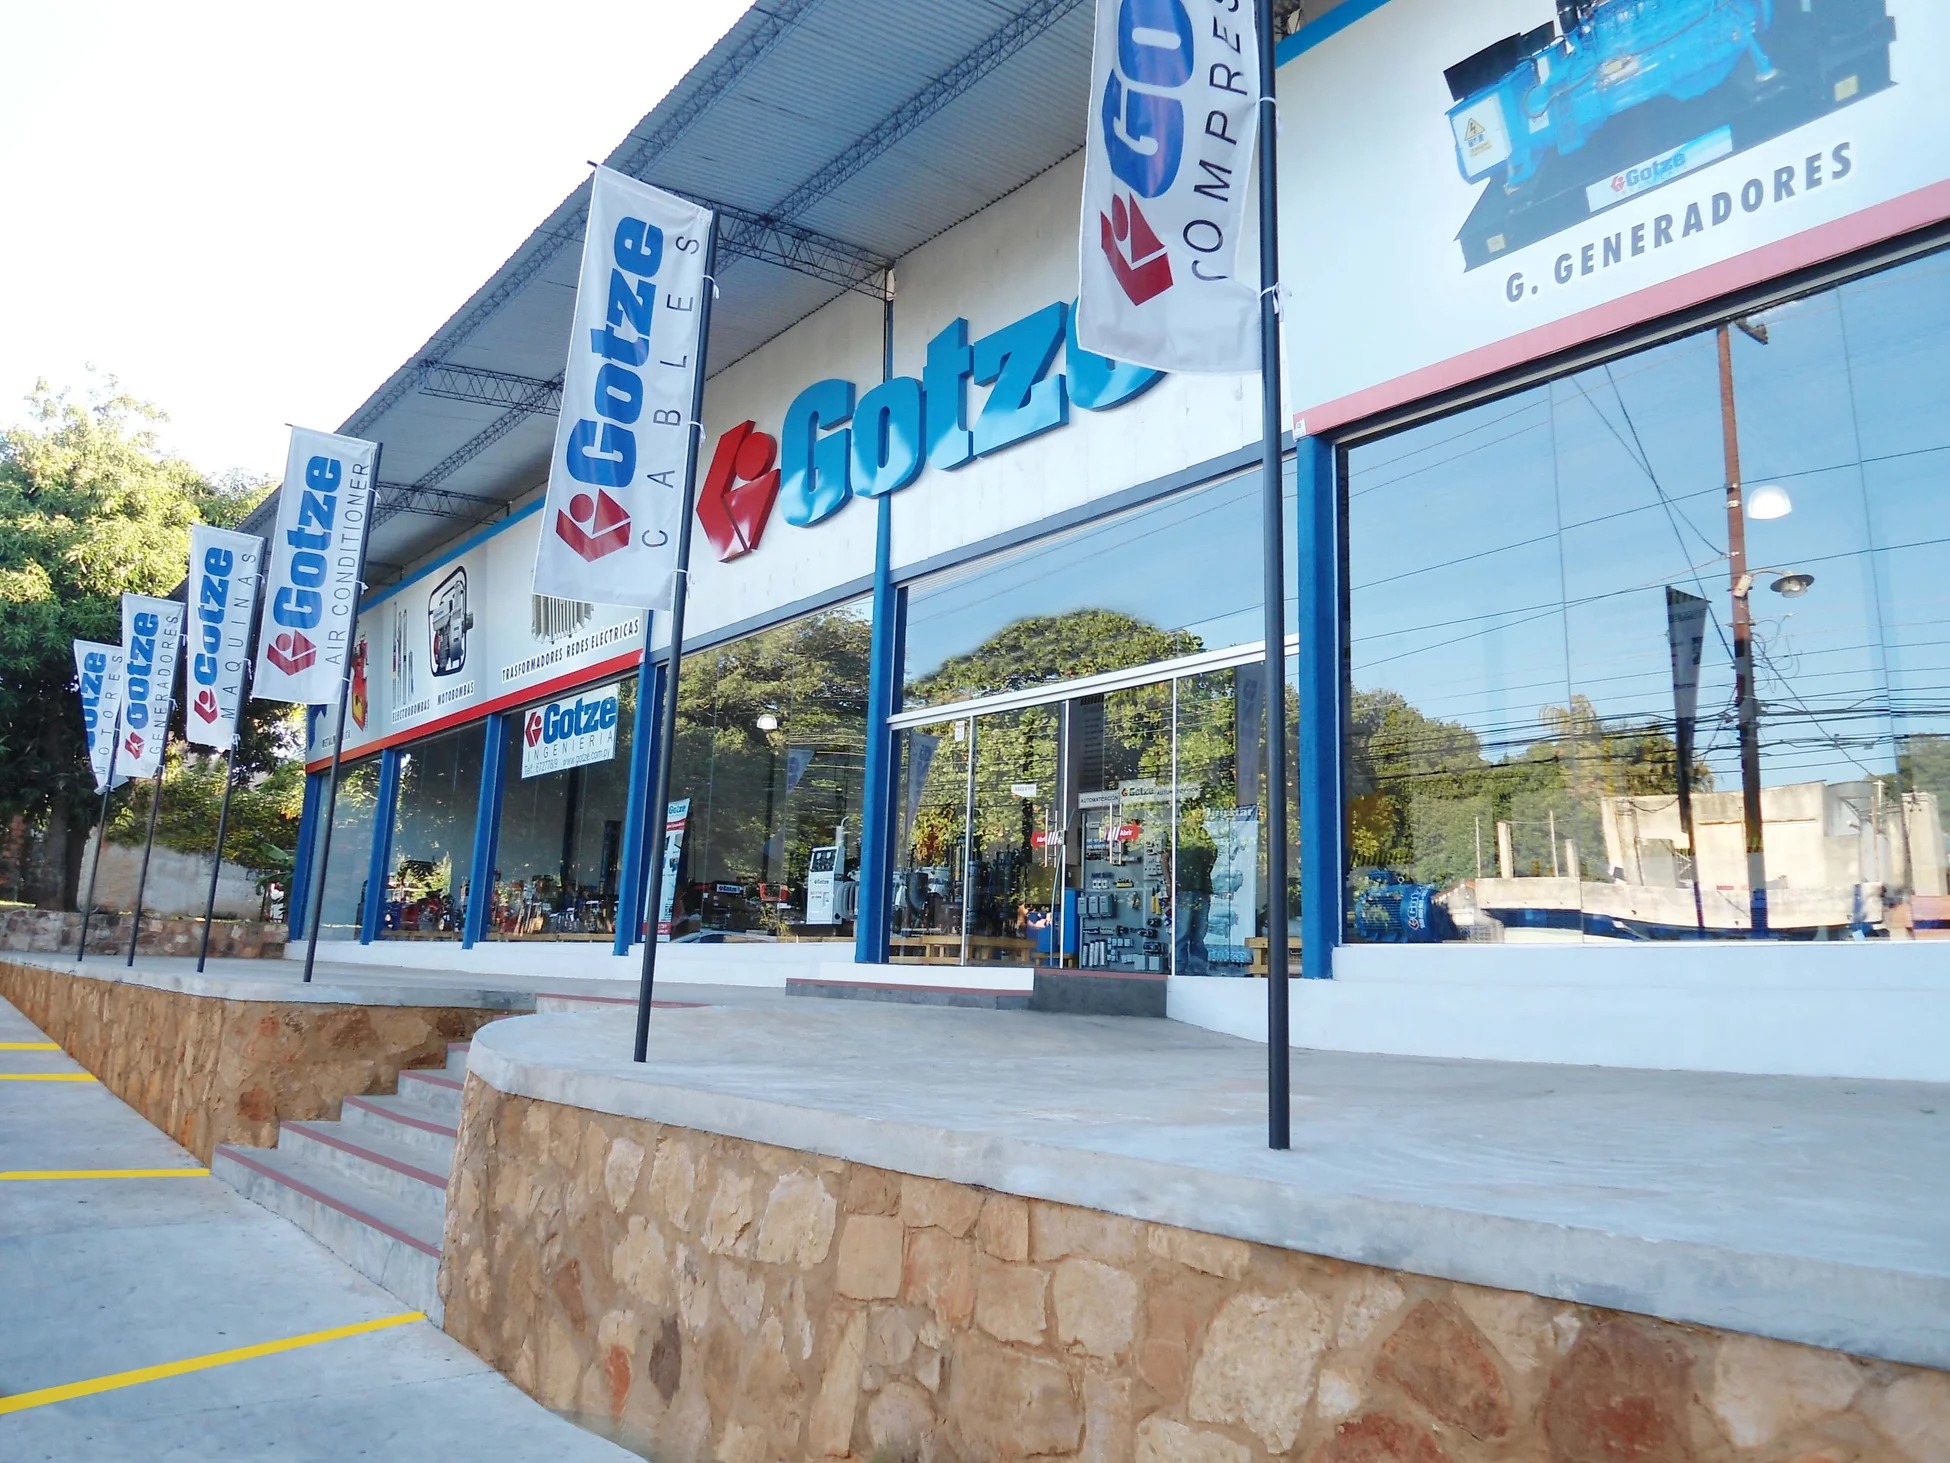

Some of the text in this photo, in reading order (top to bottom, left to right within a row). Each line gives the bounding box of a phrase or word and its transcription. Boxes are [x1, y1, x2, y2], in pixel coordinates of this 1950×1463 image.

[1553, 142, 1854, 285] GENERADORES
[1625, 151, 1686, 188] Gotze
[566, 216, 664, 488] Gotze
[641, 235, 700, 548] CABLES
[273, 455, 342, 630] Gotze
[325, 462, 369, 665] AIR CONDITIONER
[125, 611, 160, 730] Gotze
[194, 546, 234, 686] Gotze
[220, 552, 257, 720] MAQUINAS
[502, 648, 563, 682] TRASFORMADORES
[566, 638, 589, 659] REDES
[95, 655, 123, 775] MOTORES
[149, 615, 179, 755] GENERADORES
[392, 681, 475, 723] ELECTROBOMBAS MOTOBOMBAS
[543, 696, 616, 745] Gotze
[527, 730, 613, 762] INGENIERIA
[562, 748, 610, 767] www.gotze.com.py
[1120, 828, 1133, 837] Abrir
